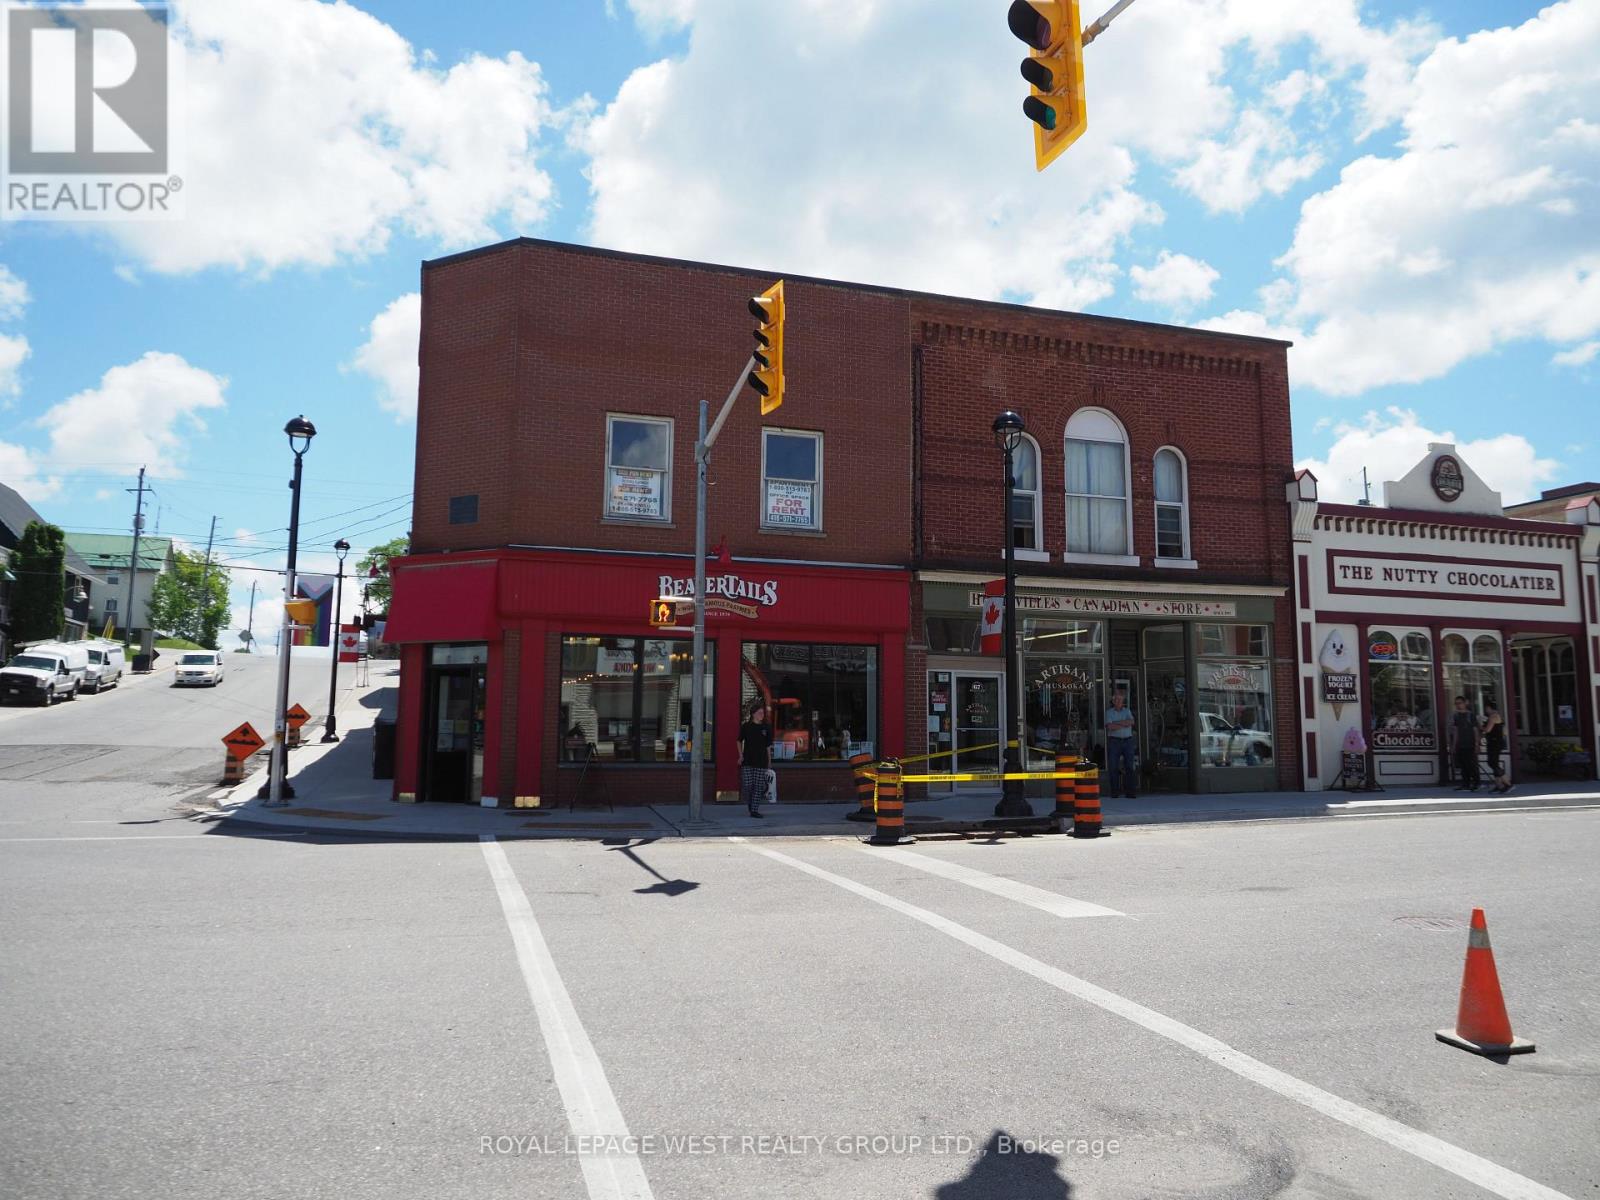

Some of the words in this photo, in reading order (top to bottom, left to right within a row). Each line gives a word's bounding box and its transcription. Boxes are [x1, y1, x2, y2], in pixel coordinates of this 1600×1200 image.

[776, 498, 802, 507] FOR
[771, 505, 807, 515] RENT
[1339, 565, 1374, 581] THE
[1383, 567, 1438, 584] NUTTY
[1447, 571, 1556, 591] CHOCOLATIER
[1073, 599, 1140, 613] CANADIAN
[1162, 601, 1203, 615] STORE
[1336, 693, 1357, 701] CREAM
[1376, 733, 1431, 747] Chocolate
